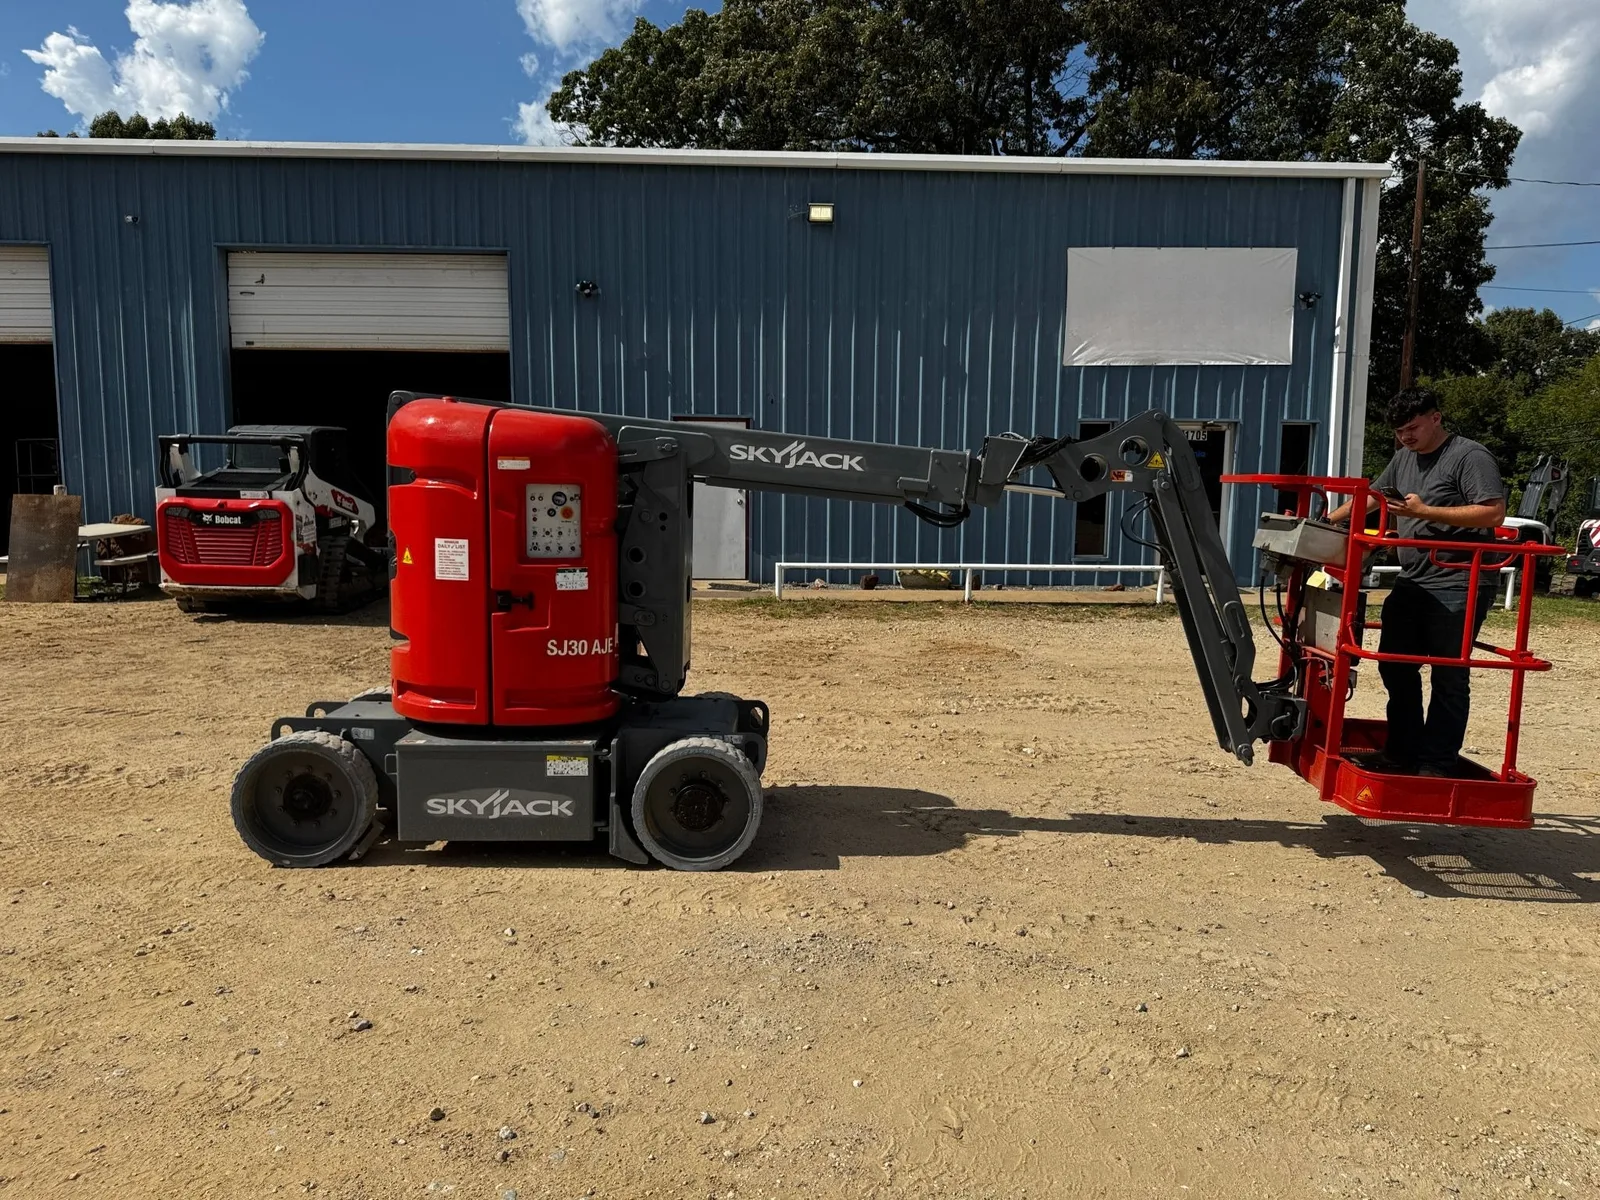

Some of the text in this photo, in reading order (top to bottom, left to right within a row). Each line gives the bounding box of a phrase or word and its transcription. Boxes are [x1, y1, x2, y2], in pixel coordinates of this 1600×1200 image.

[729, 440, 865, 472] SKYJACK
[215, 515, 241, 524] Bobcat
[547, 637, 613, 656] SJ30 AJE
[426, 789, 574, 819] SKYJACK
